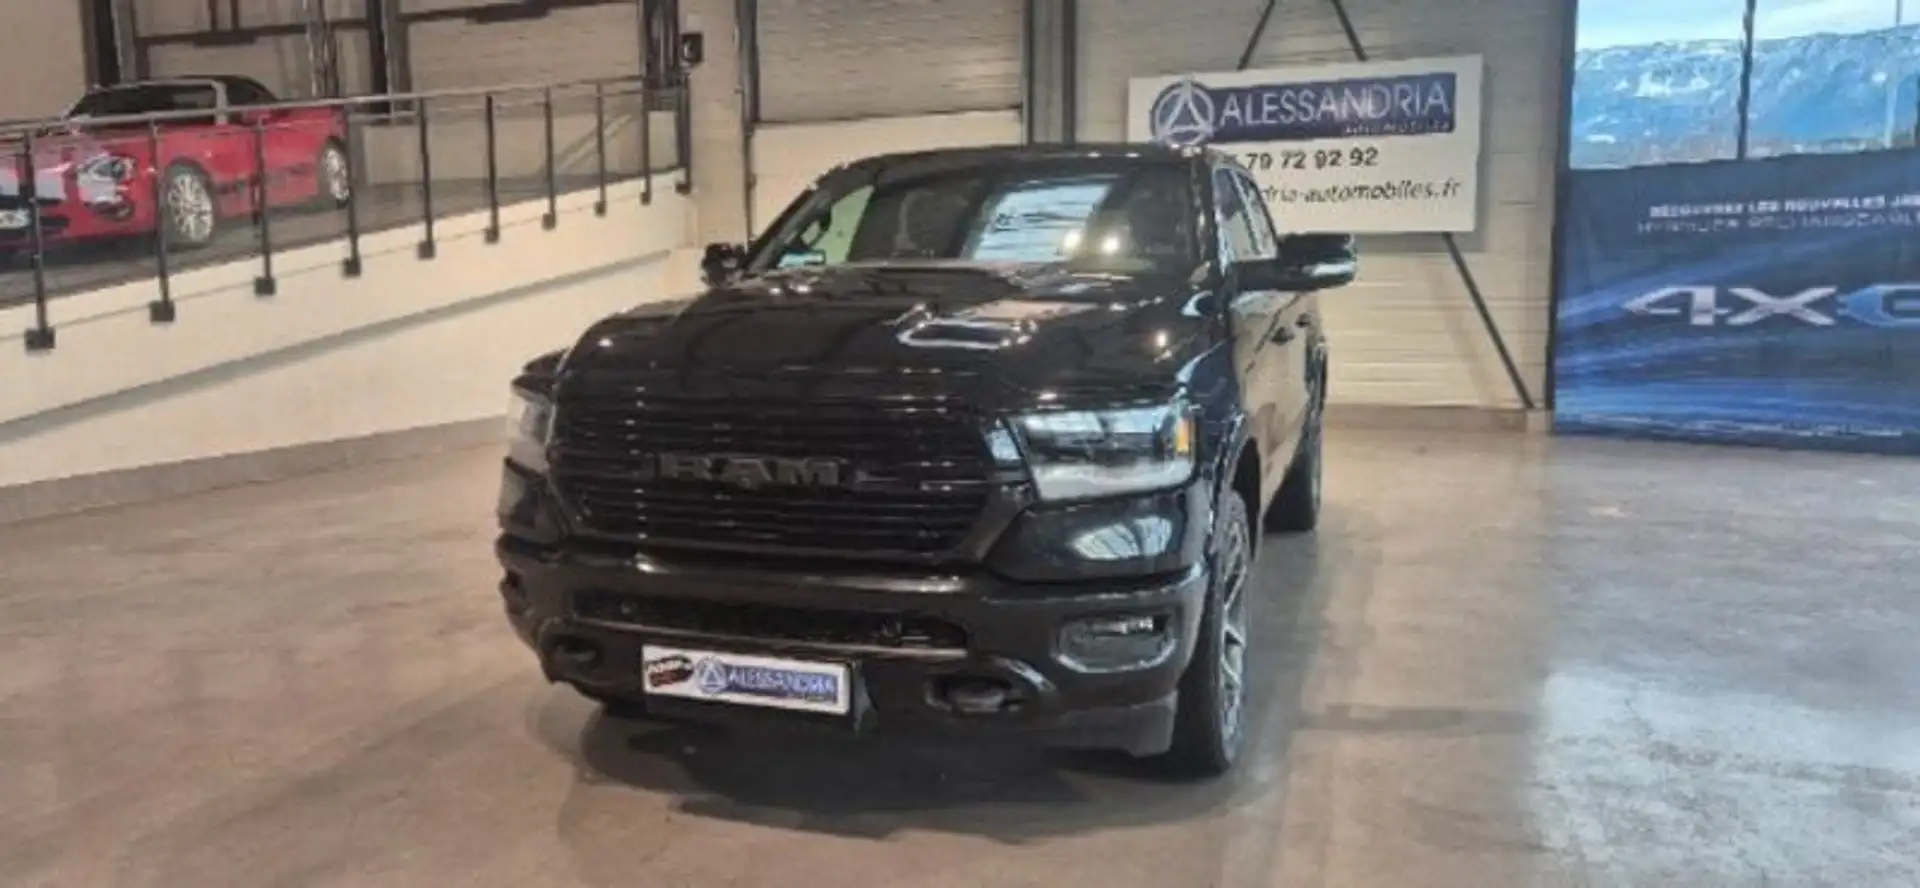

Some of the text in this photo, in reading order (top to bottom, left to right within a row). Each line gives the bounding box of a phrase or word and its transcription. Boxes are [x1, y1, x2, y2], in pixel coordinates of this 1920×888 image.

[1219, 82, 1450, 127] ALESSANDRIA
[1281, 150, 1307, 169] 72
[1315, 150, 1342, 170] 92
[1350, 147, 1379, 167] 92
[656, 452, 849, 488] RAM
